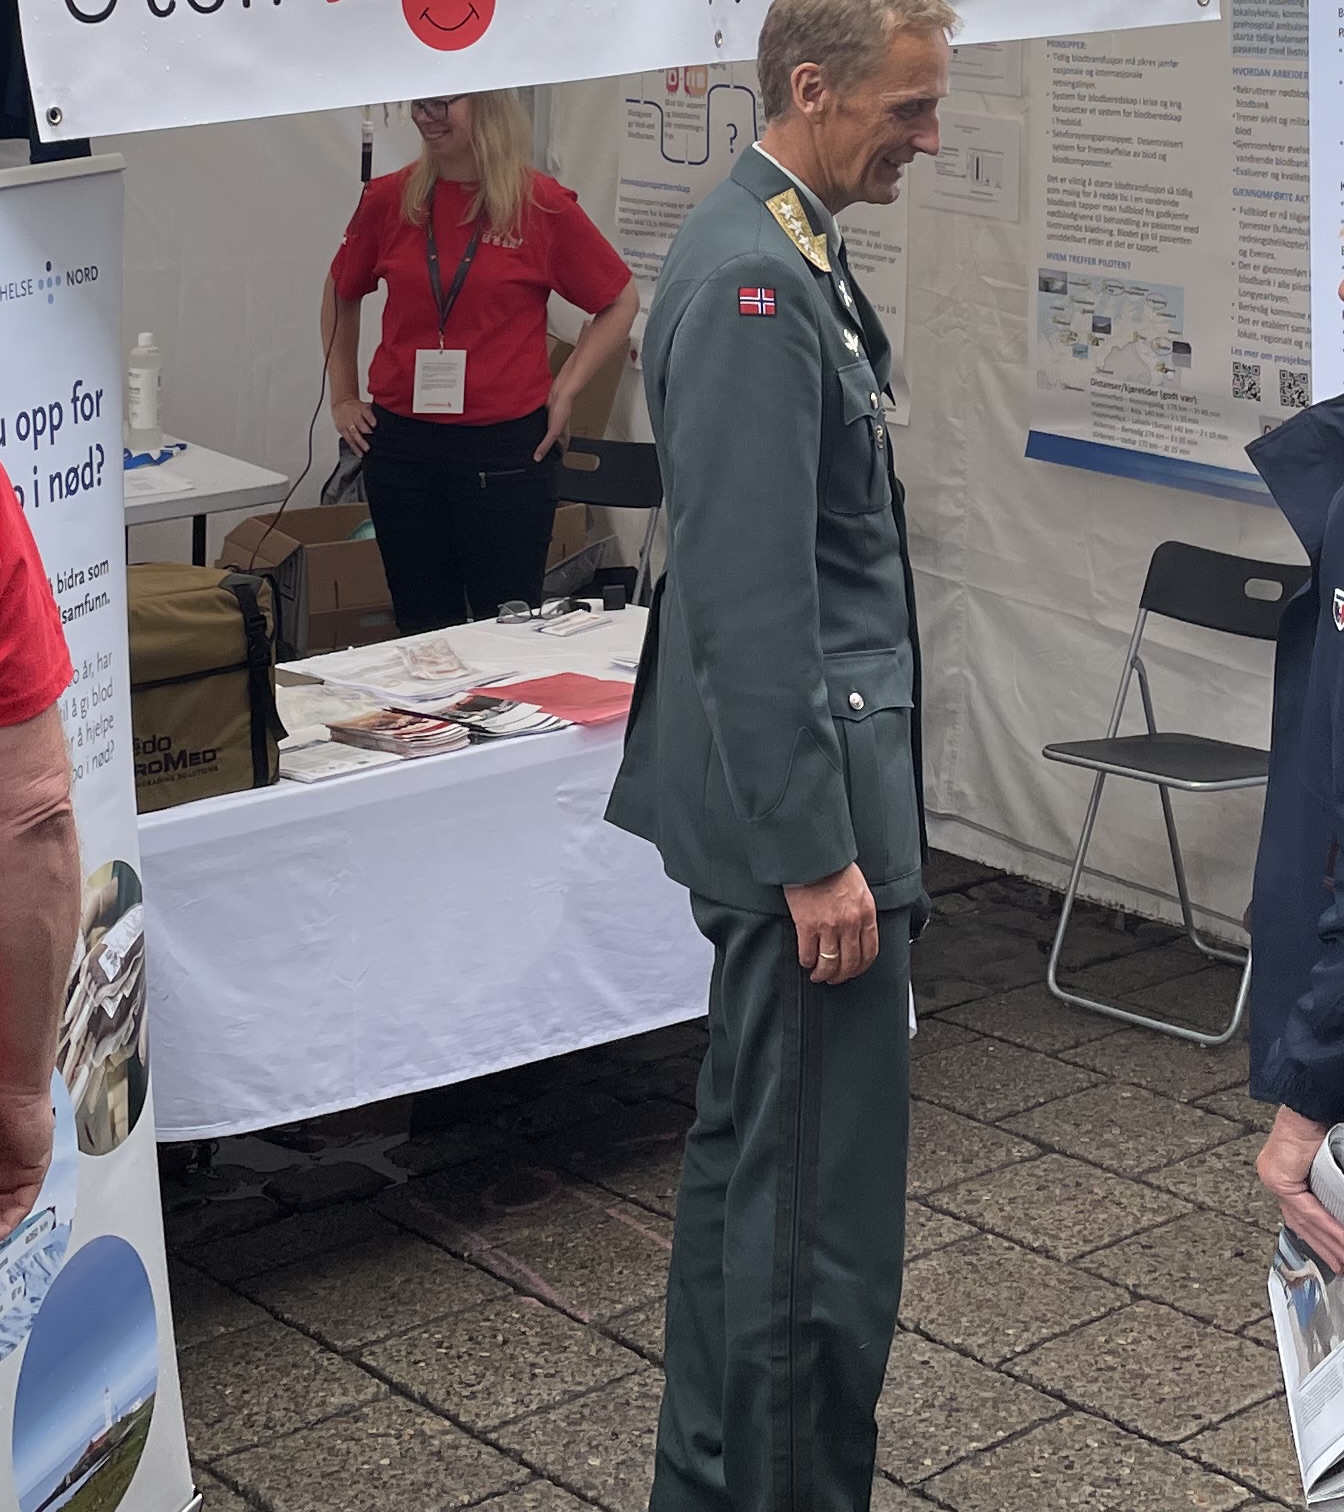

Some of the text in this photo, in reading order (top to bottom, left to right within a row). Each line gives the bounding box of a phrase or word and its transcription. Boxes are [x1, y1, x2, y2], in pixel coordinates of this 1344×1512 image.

[1233, 68, 1270, 78] HVORDAN
[1047, 252, 1131, 270] HVEM TREFFER PILOTEN?
[0, 266, 98, 302] HELSE NORD
[16, 402, 63, 450] opp
[71, 380, 103, 424] for
[33, 465, 39, 507] i
[49, 443, 105, 504] nød?
[57, 568, 85, 594] bidra
[88, 559, 109, 581] som
[97, 650, 113, 673] har
[72, 698, 77, 718] å
[80, 690, 90, 719] gi
[93, 678, 113, 706] blod
[77, 727, 83, 747] å
[86, 713, 114, 739] hjelpe
[92, 740, 115, 771] nød?
